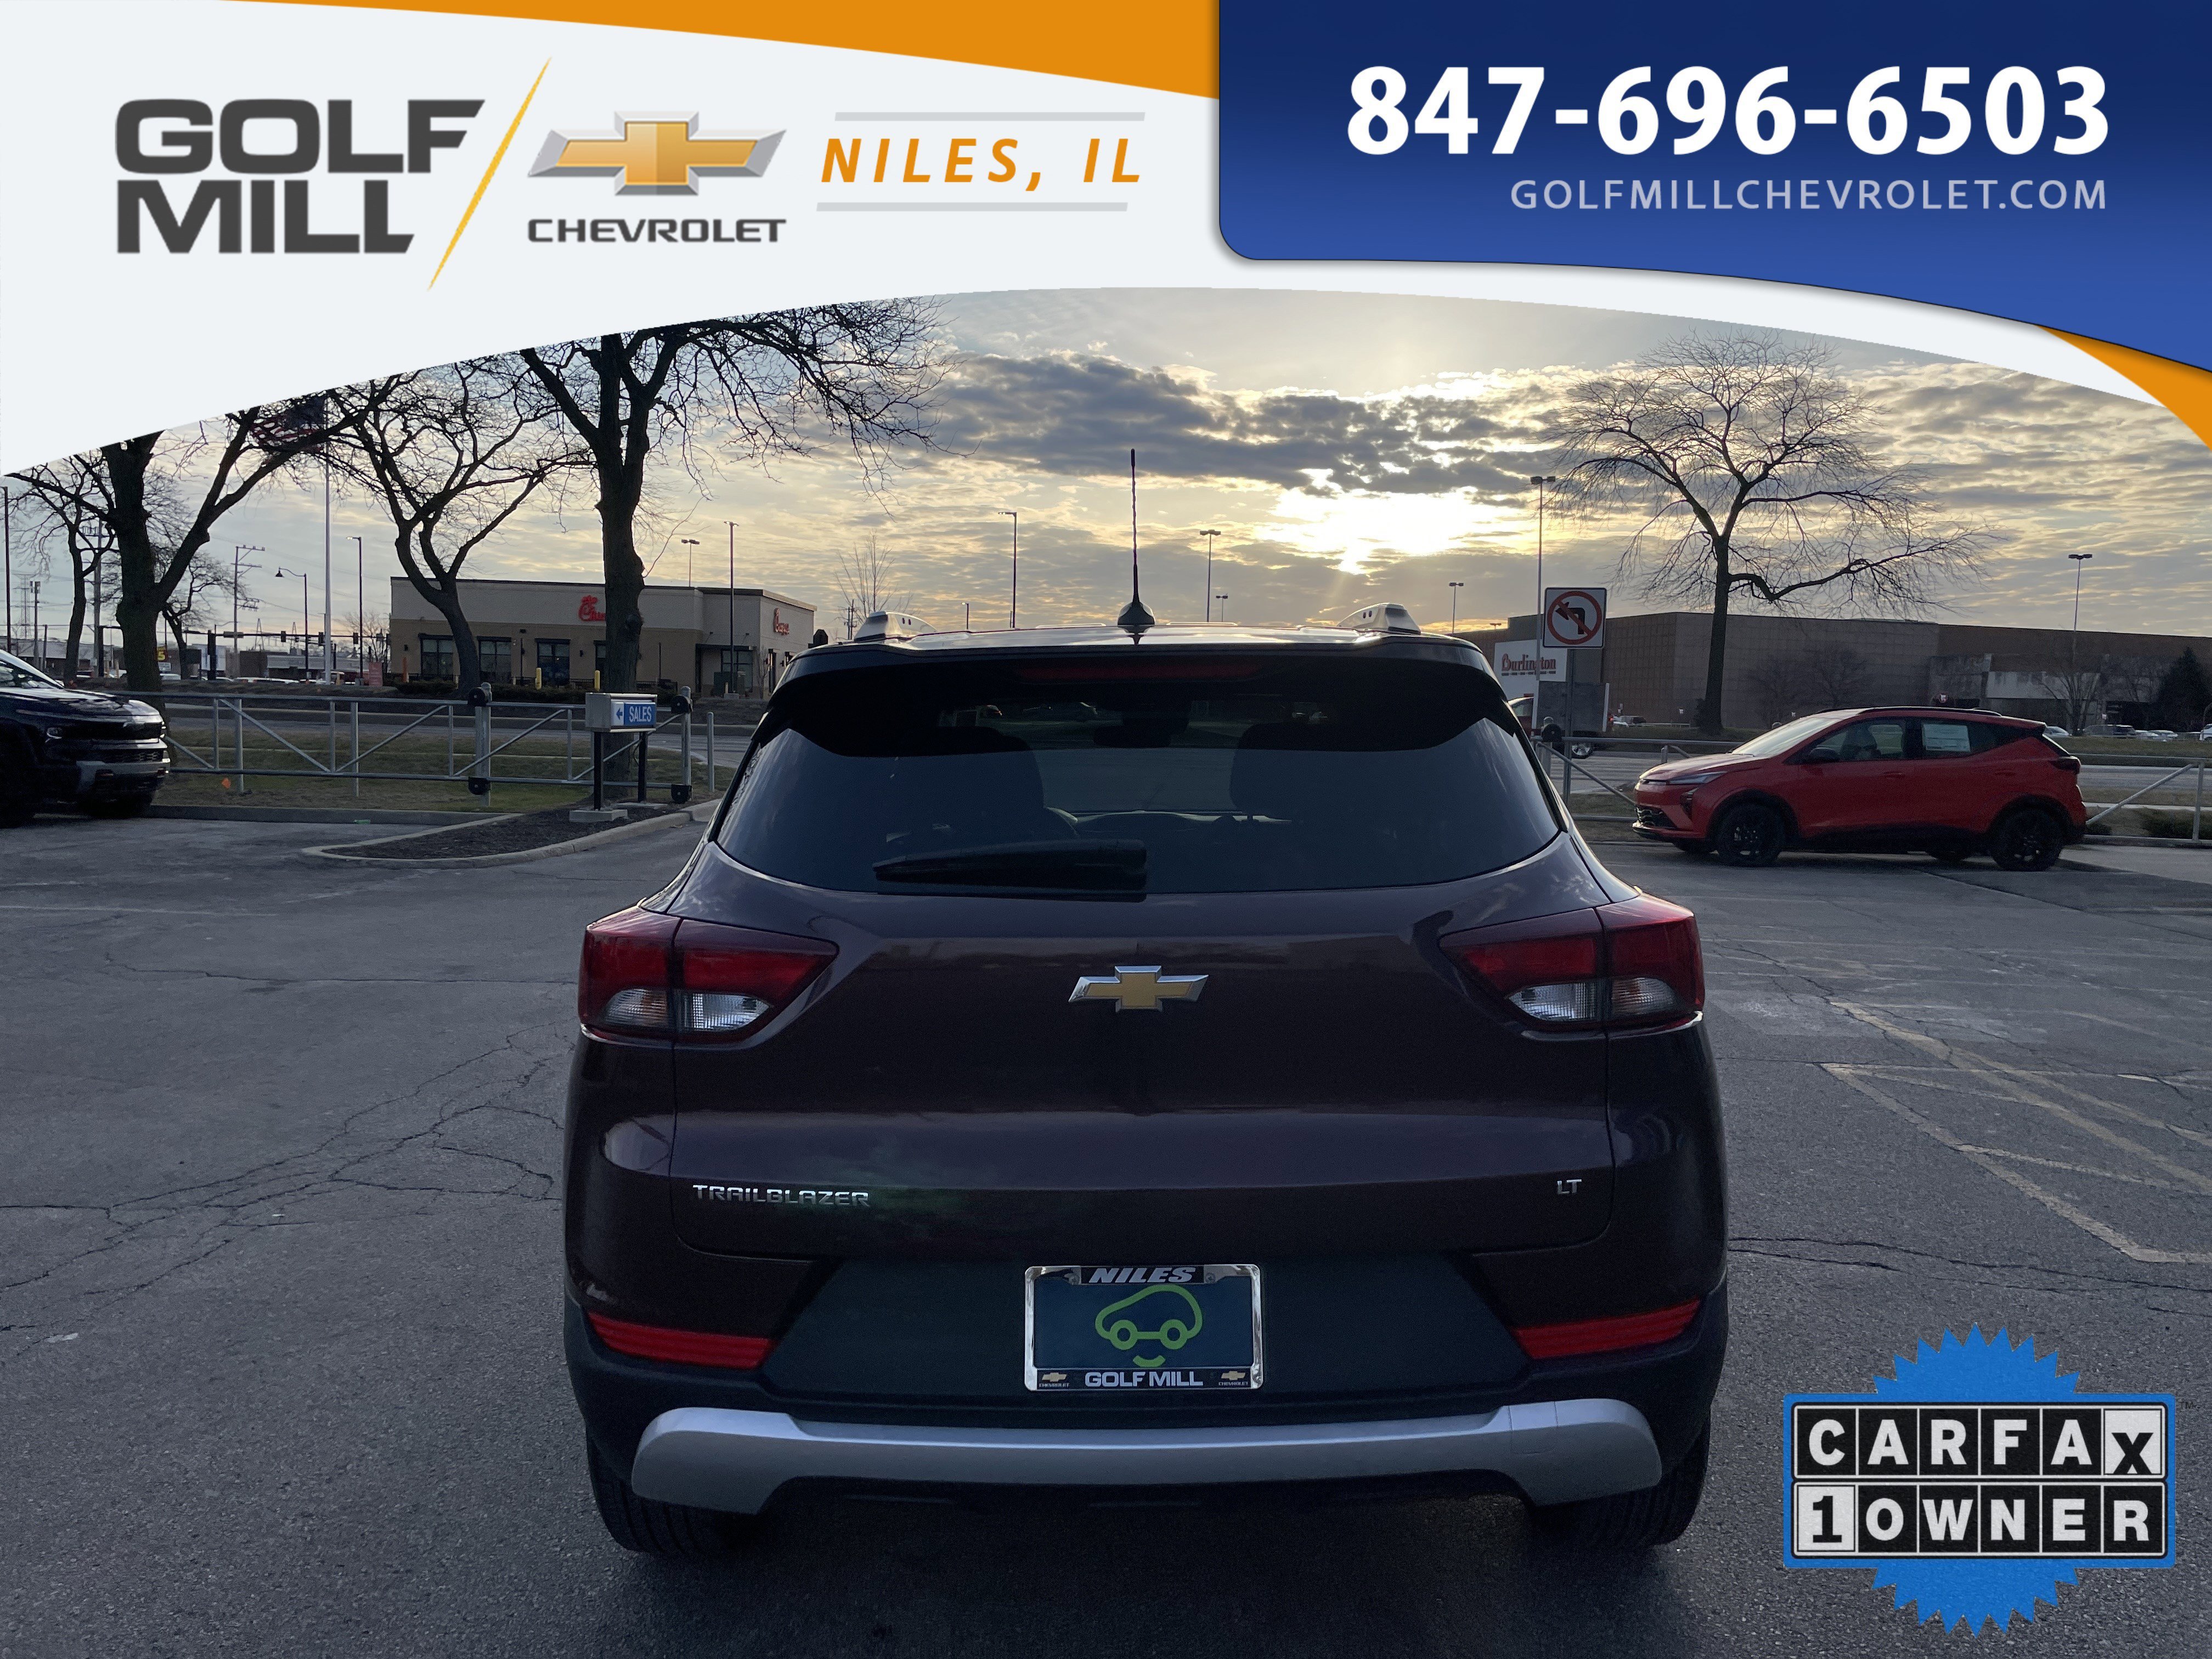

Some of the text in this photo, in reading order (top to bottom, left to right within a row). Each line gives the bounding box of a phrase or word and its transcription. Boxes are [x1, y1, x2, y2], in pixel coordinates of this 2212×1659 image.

[629, 706, 652, 723] SALES
[1557, 1179, 1582, 1194] LT
[692, 1184, 871, 1207] TRAILBLAZER
[1088, 1267, 1196, 1283] NILES
[1085, 1371, 1204, 1387] GOLF MILL
